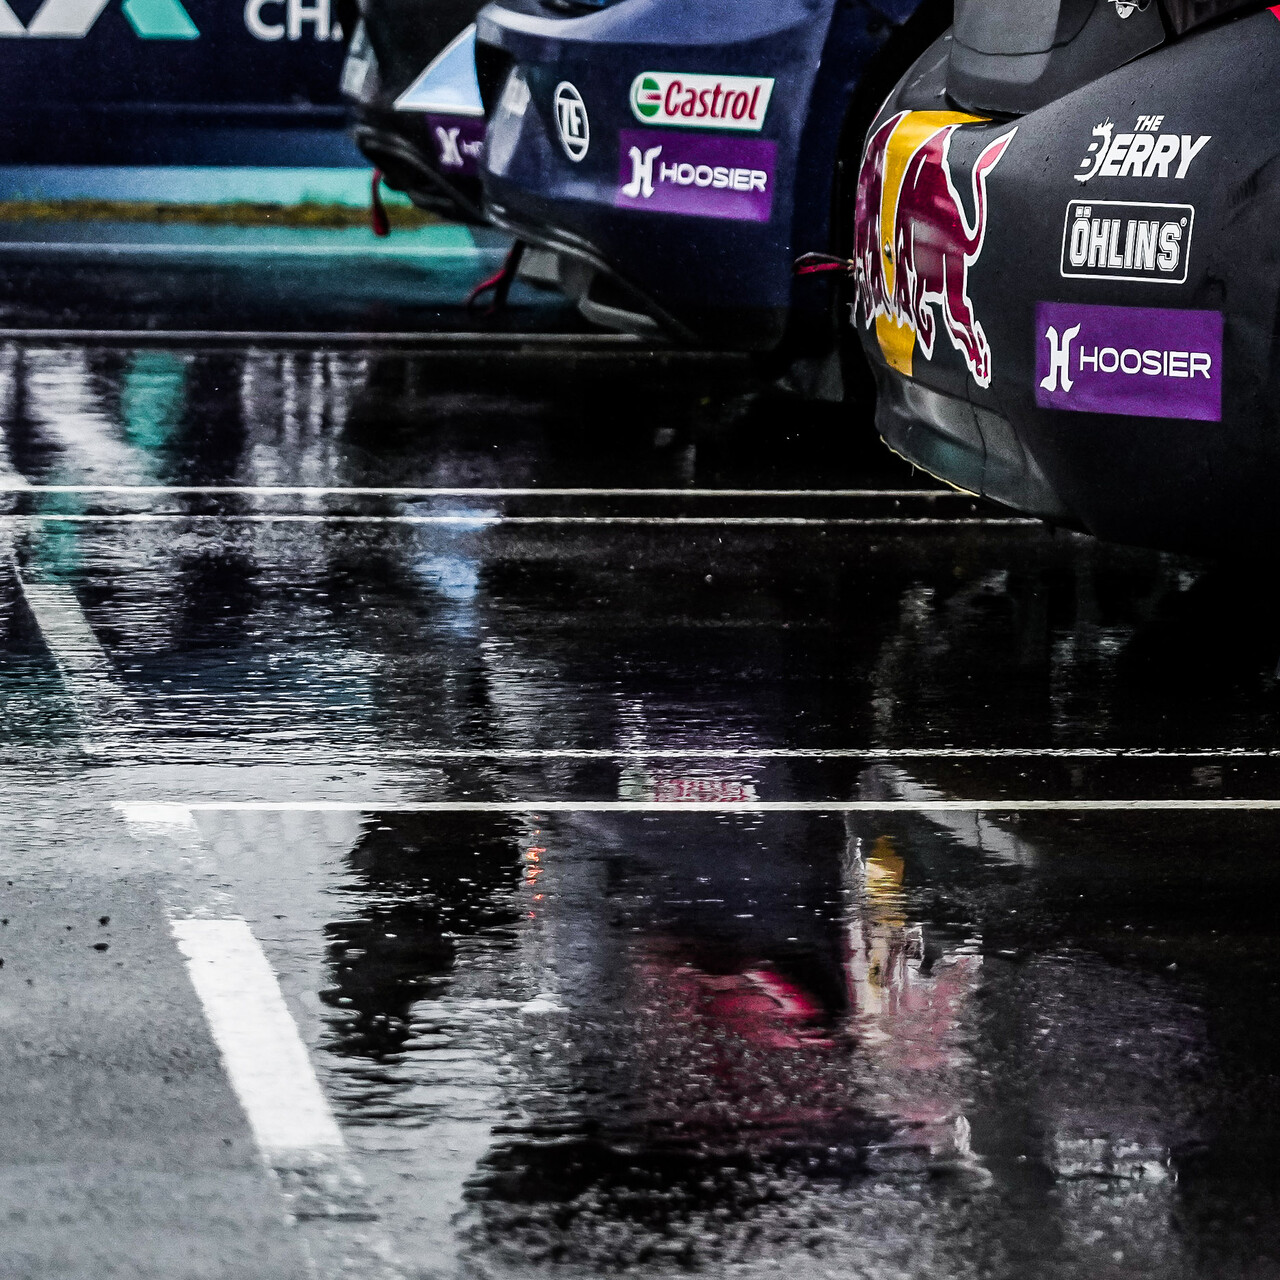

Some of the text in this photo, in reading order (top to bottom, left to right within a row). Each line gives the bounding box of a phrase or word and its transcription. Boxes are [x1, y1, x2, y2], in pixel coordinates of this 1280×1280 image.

[664, 79, 758, 120] Castrol
[1134, 115, 1164, 131] THE
[1074, 116, 1212, 181] BERRY
[660, 161, 767, 193] HOOSIER
[1069, 206, 1183, 272] ÖHLINS
[1079, 344, 1212, 380] HOOSIER
